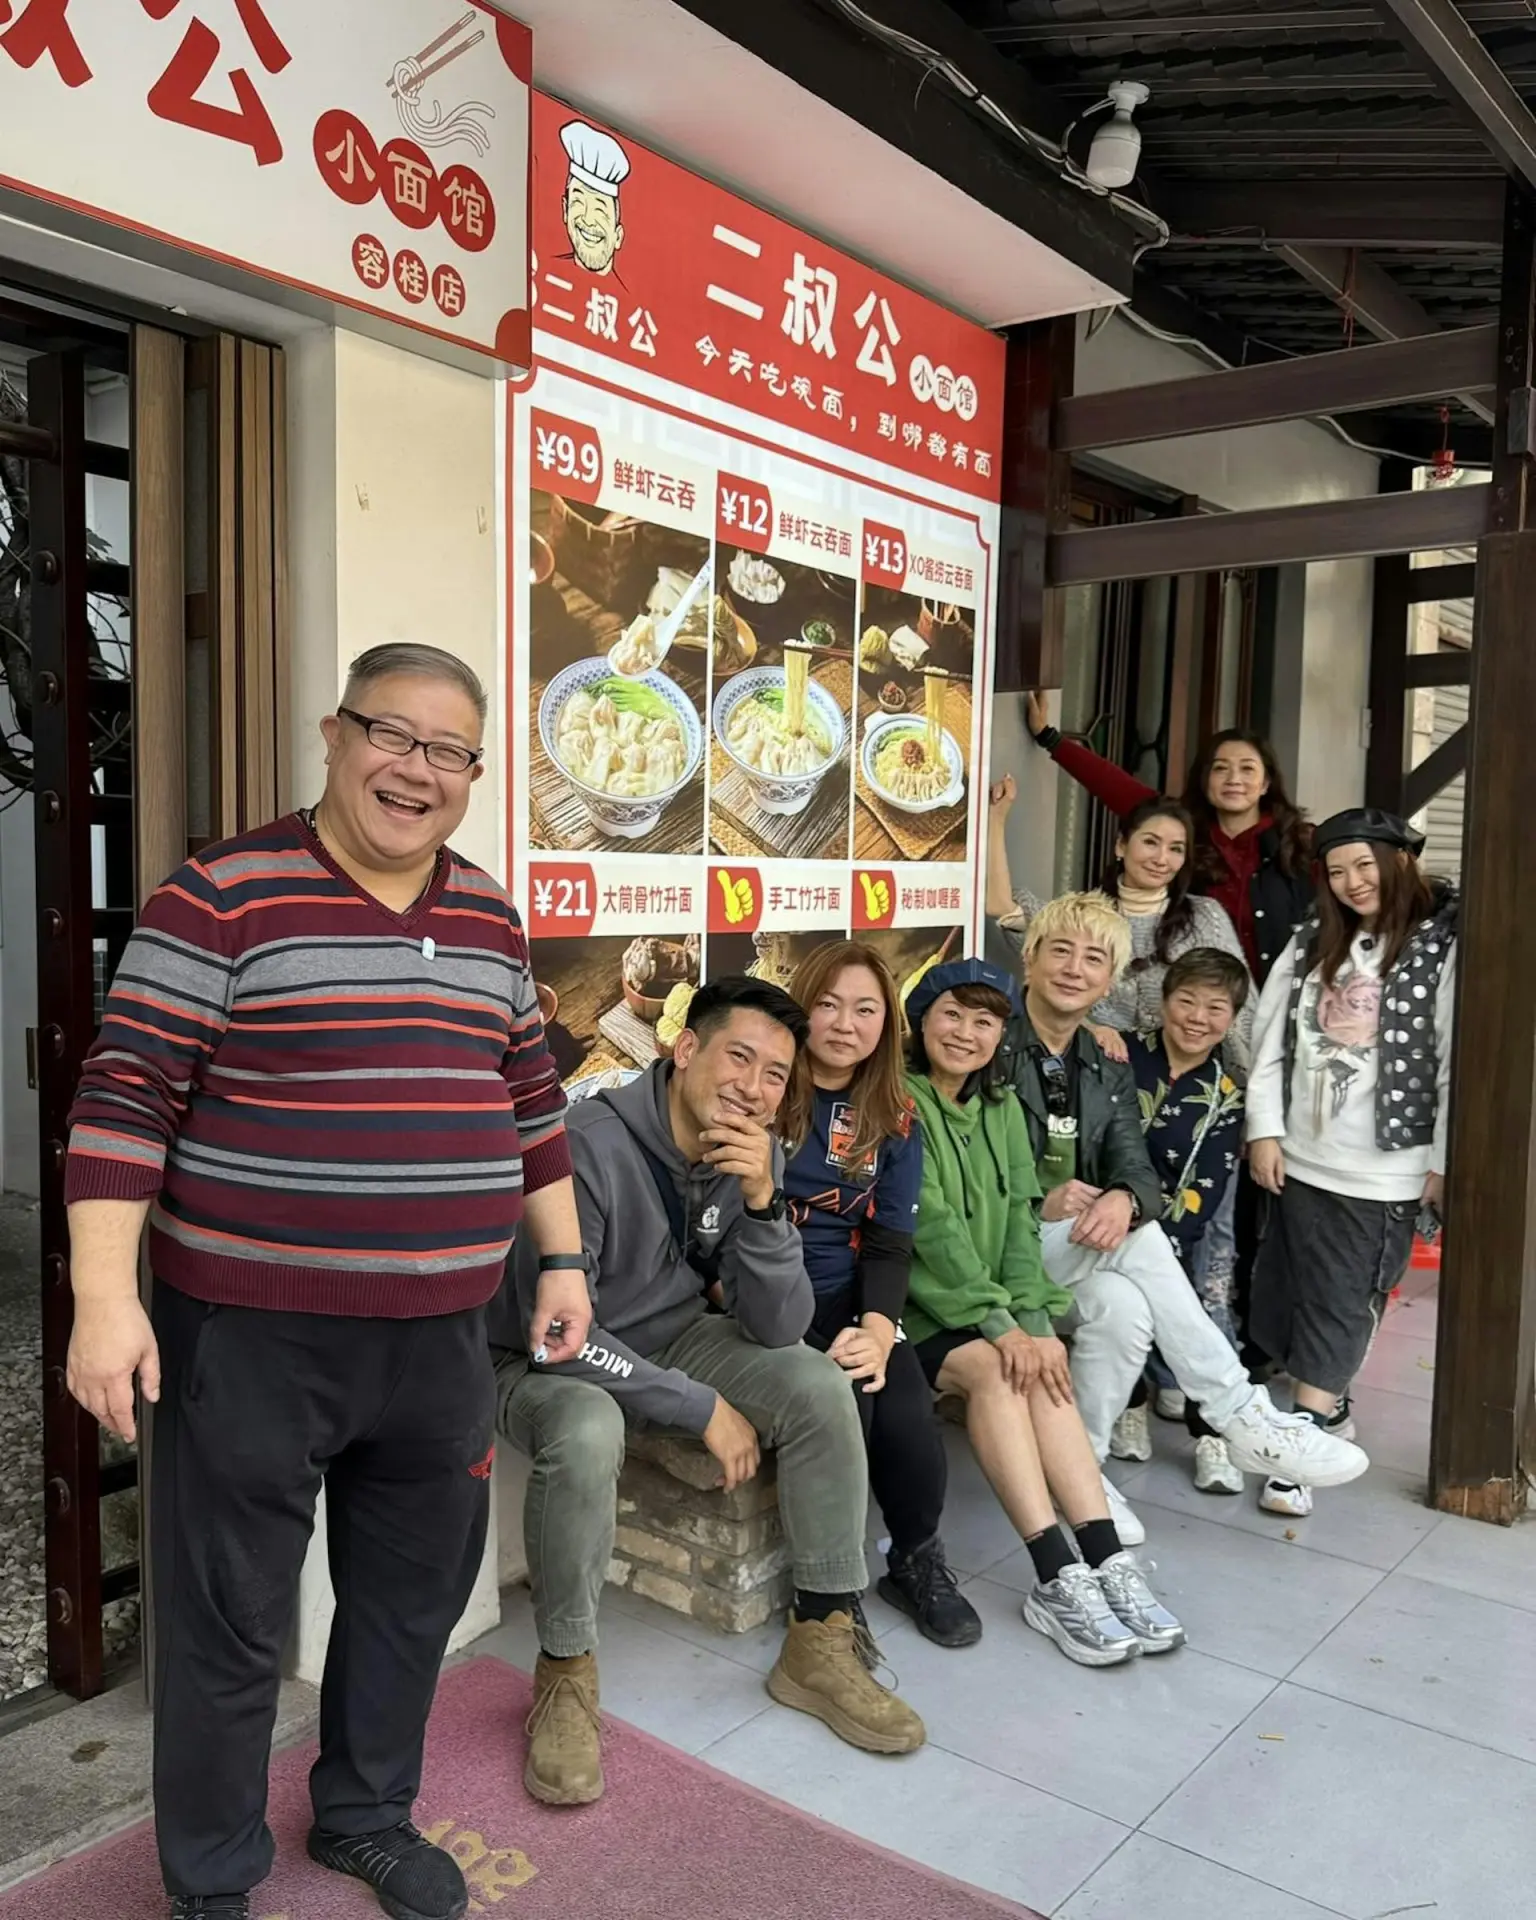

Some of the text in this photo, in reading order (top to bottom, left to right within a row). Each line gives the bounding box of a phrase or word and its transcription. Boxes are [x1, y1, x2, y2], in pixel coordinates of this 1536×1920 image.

[325, 128, 487, 238] 小面馆
[357, 241, 462, 312] 容桂店
[541, 273, 659, 358] 二叔公
[706, 224, 901, 386] 二叔公
[914, 365, 974, 413] 小面馆
[535, 426, 599, 484] ¥9.9
[613, 458, 696, 512] 鲜虾云吞
[720, 487, 769, 536] ¥12
[778, 511, 852, 558] 鲜虾云吞面
[864, 532, 904, 575] ¥13
[534, 878, 591, 917] ¥21
[602, 884, 692, 914] 大筒骨竹升面
[769, 886, 841, 911] 手工竹升面
[901, 887, 961, 911] 秘制咖喱酱
